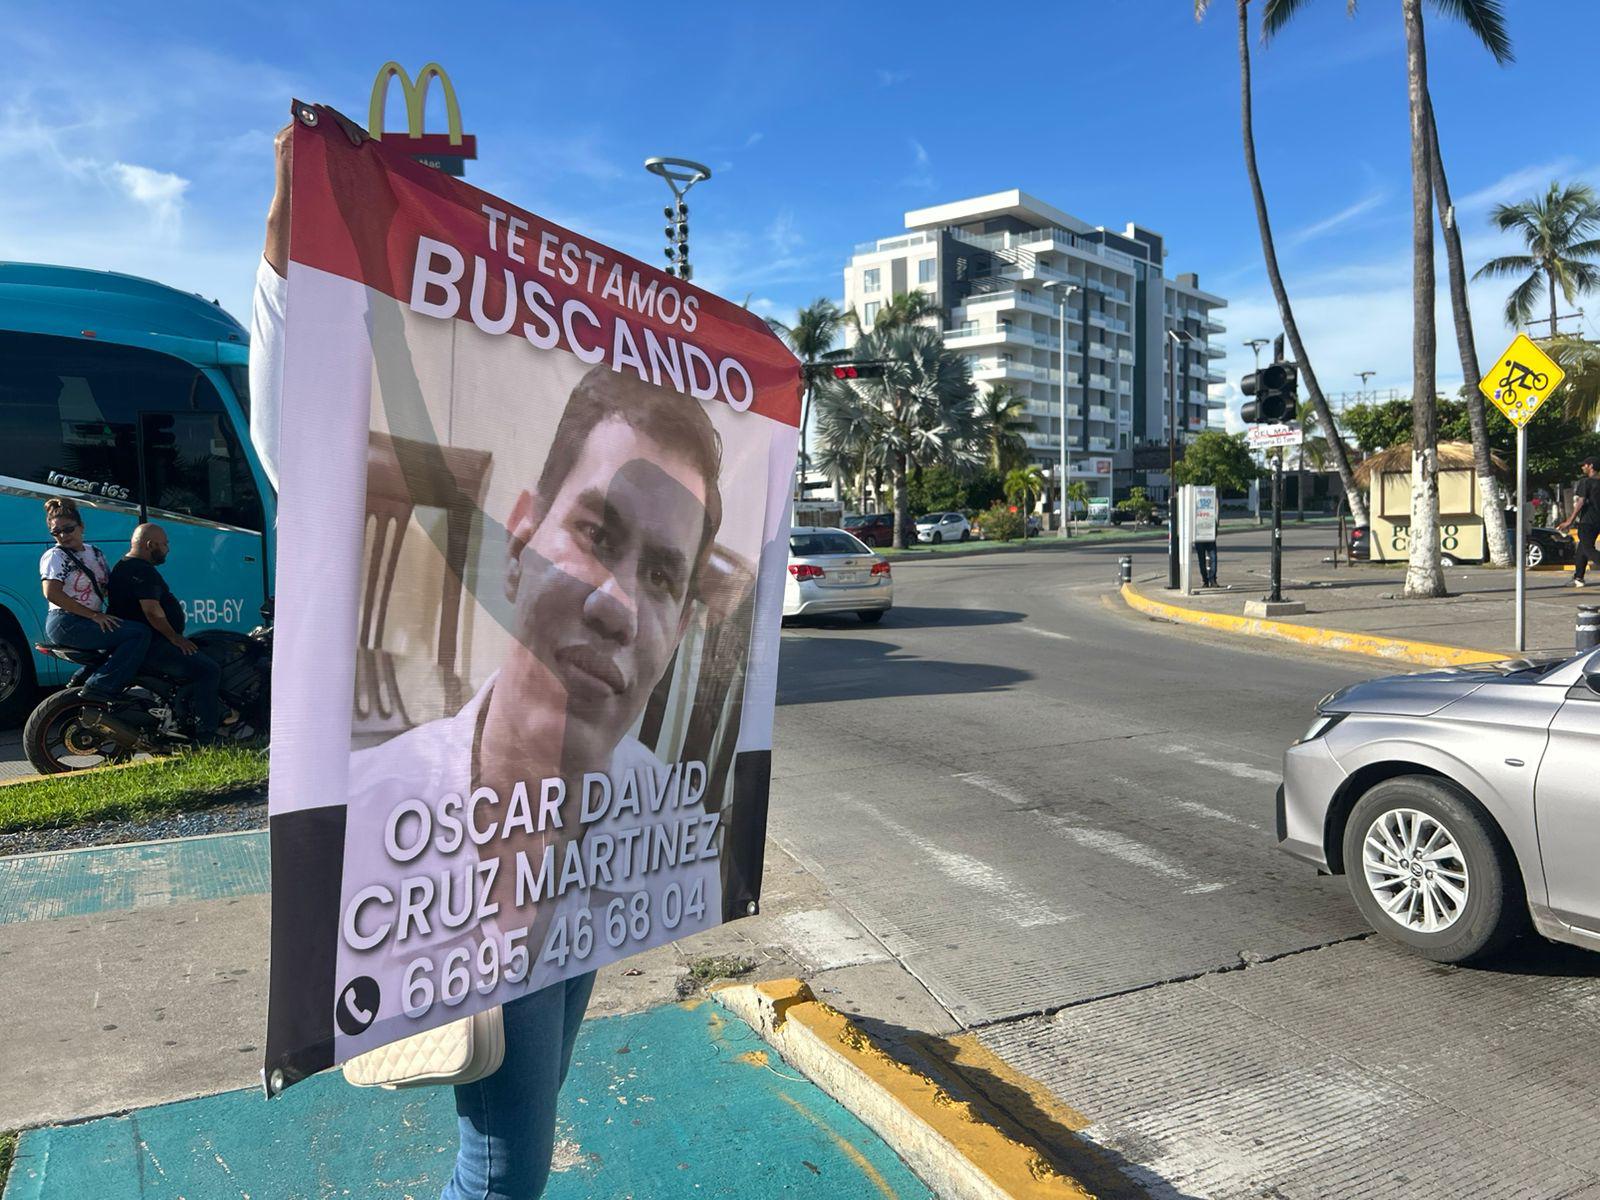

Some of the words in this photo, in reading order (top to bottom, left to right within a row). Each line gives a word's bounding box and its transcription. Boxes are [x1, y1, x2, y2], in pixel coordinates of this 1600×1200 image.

[409, 235, 754, 413] BUSCANDO
[481, 203, 529, 264] TE
[538, 230, 700, 332] ESTAMOS
[101, 482, 130, 499] i6s
[384, 776, 567, 862] OSCAR
[580, 760, 708, 824] DAVID
[343, 857, 500, 950] CRUZ
[516, 812, 721, 907] MARTINEZ
[402, 927, 529, 1019] 6695
[543, 907, 594, 967] 46
[606, 891, 650, 948] 68
[662, 878, 705, 929] 04
